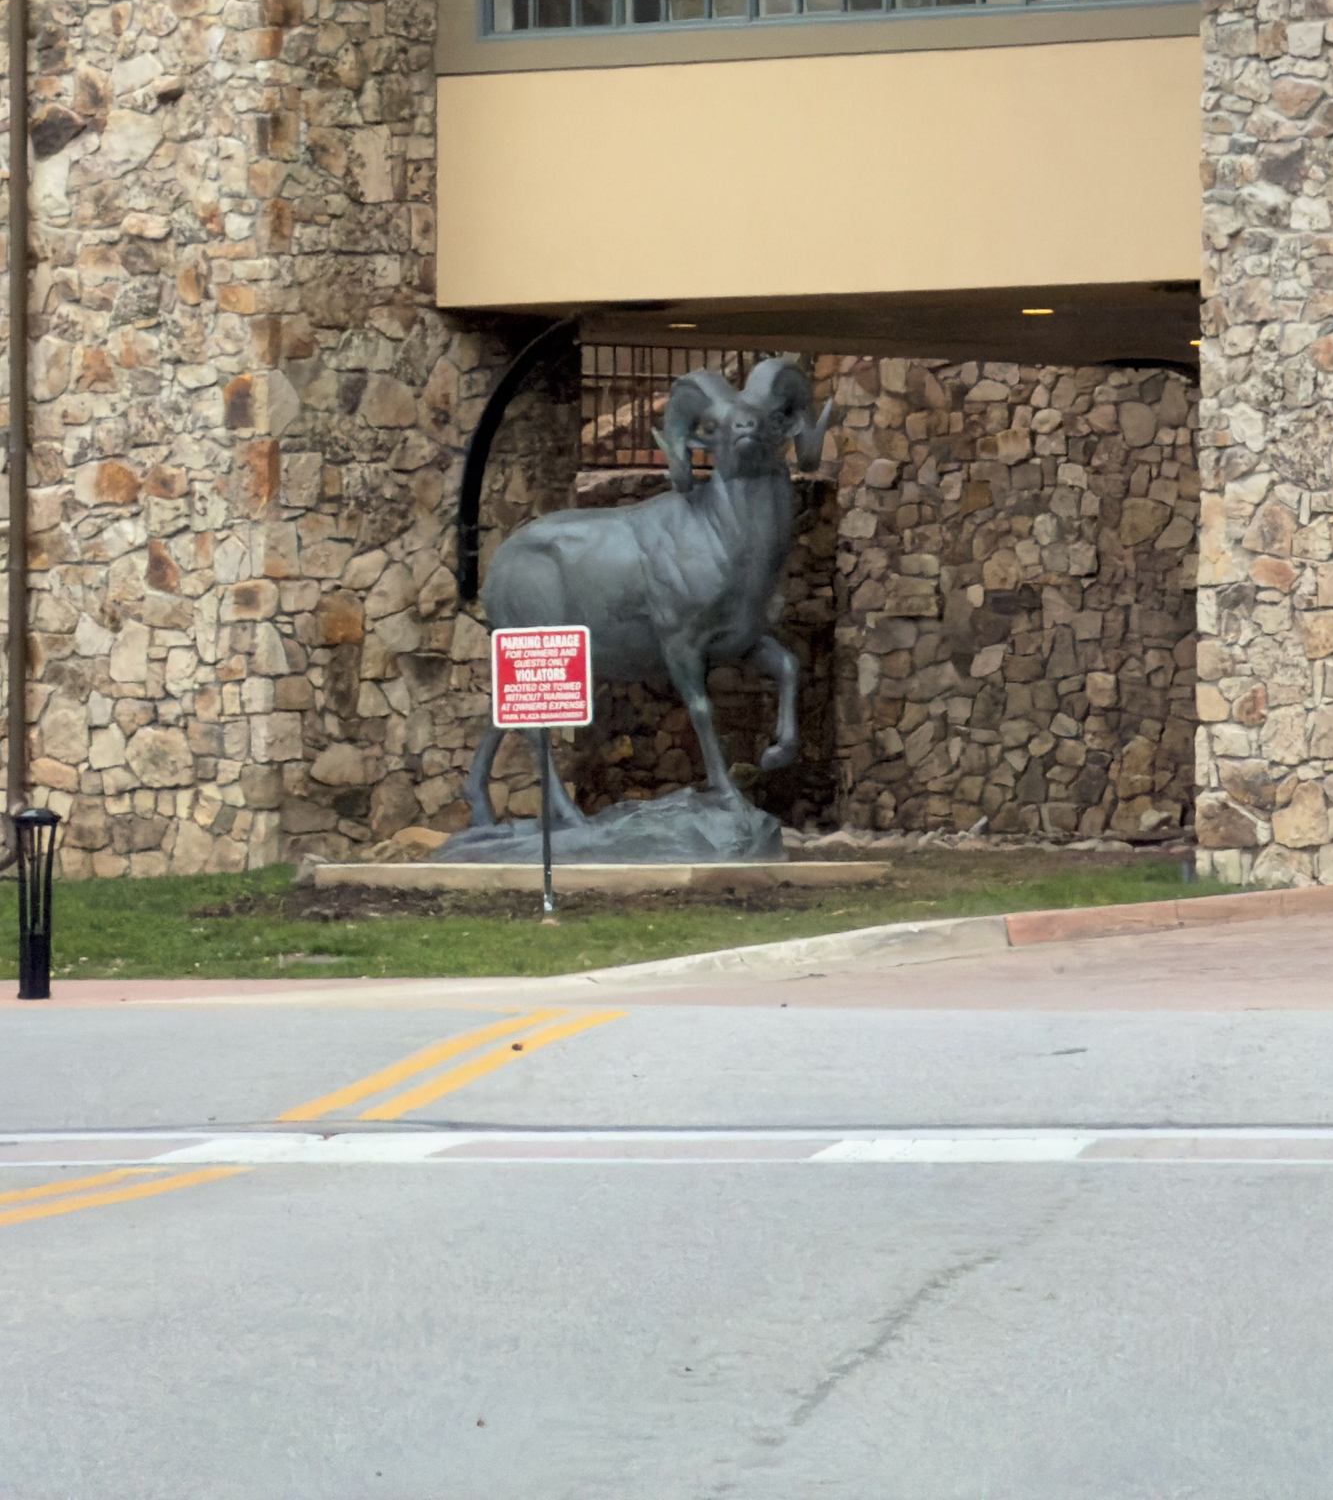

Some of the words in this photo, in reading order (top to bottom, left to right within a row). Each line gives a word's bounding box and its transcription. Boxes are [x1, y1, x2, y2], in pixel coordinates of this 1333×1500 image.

[500, 635, 541, 650] PARKING
[542, 634, 580, 648] GARAGE
[505, 650, 522, 659] FOR
[523, 649, 558, 658] OWNERS
[559, 648, 577, 657] AND
[513, 659, 546, 668] GUESTS
[547, 658, 569, 667] ONLY
[515, 668, 567, 682] VIOLATORS
[503, 683, 537, 693] BOOTED
[538, 683, 551, 691] OR
[552, 682, 582, 691] TOWED
[504, 693, 541, 702] WITHOUT
[543, 692, 580, 701] WARNING
[501, 702, 512, 712] AT
[549, 700, 586, 710] EXPENSE
